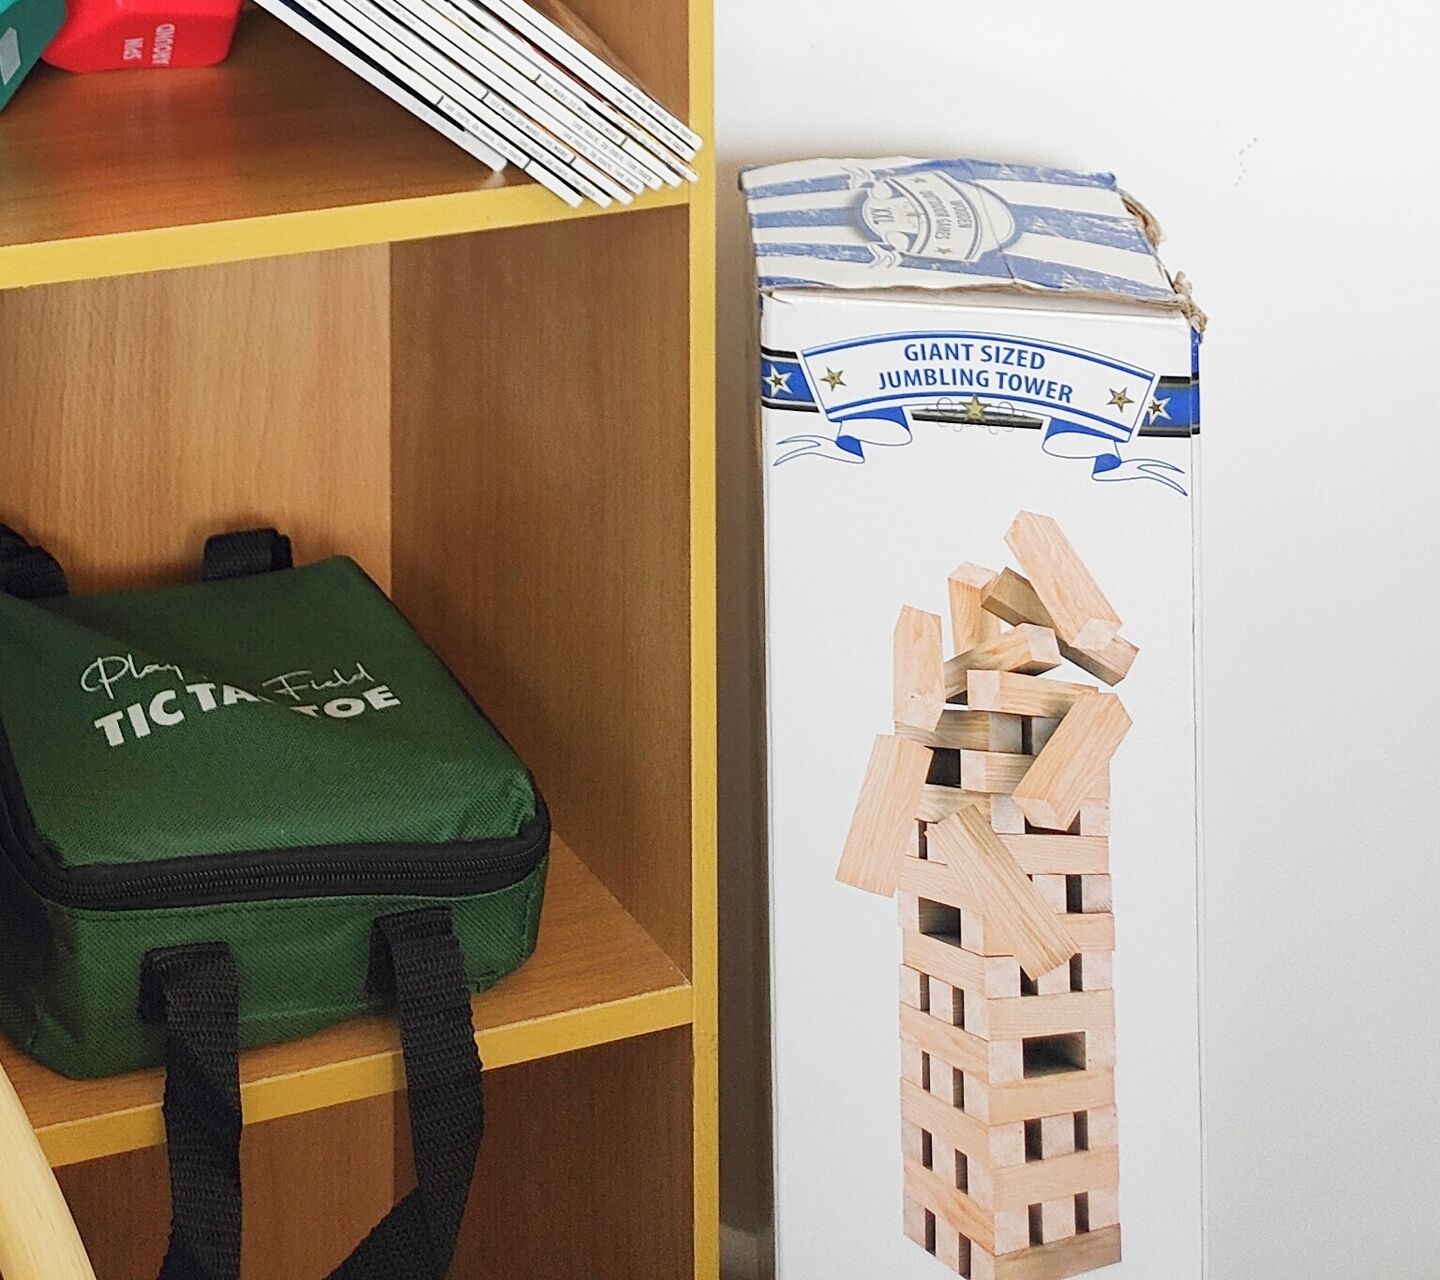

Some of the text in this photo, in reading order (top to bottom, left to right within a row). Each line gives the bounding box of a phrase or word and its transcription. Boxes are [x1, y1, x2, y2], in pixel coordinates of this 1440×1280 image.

[903, 342, 1047, 371] GIANT SIZED
[878, 368, 1074, 405] JUMBLING TOWER
[80, 653, 185, 701] Play
[261, 662, 375, 701] Field
[94, 689, 186, 747] TIC
[186, 682, 276, 713] TA
